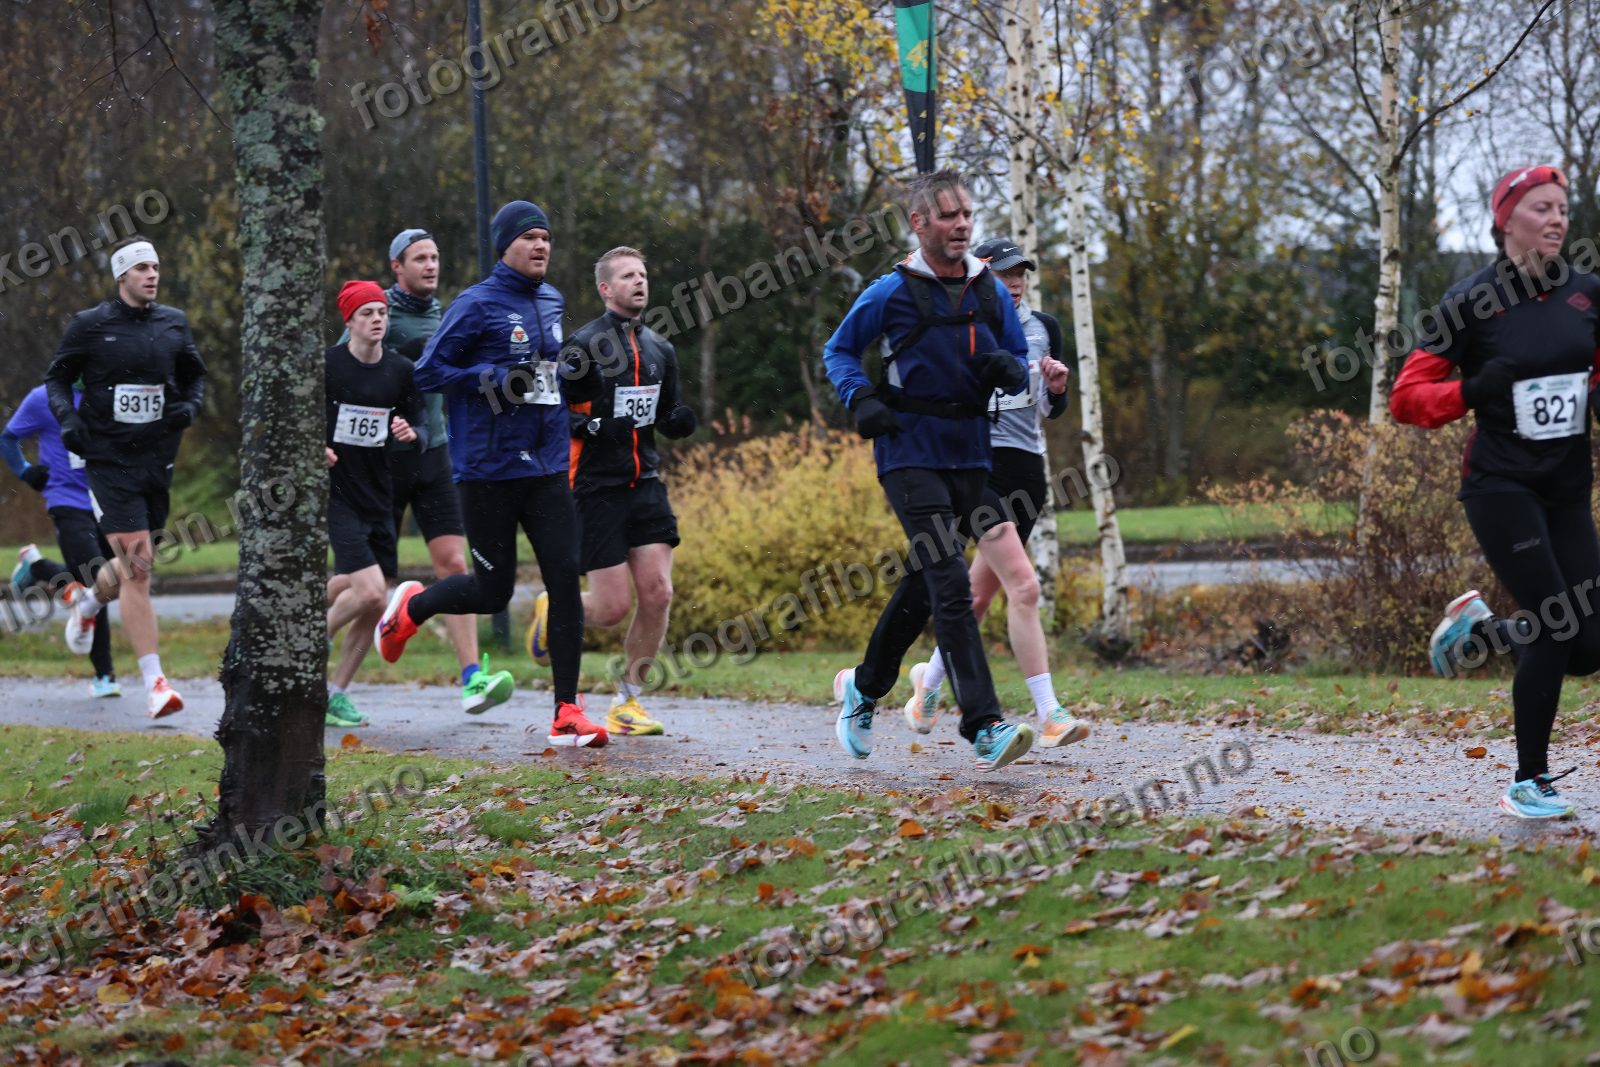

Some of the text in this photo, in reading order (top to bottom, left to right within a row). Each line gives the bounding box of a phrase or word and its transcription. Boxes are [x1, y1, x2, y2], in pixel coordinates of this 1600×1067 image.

[120, 394, 161, 413] 9315
[625, 397, 653, 418] 385
[1533, 393, 1578, 426] 821
[349, 416, 380, 438] 165
